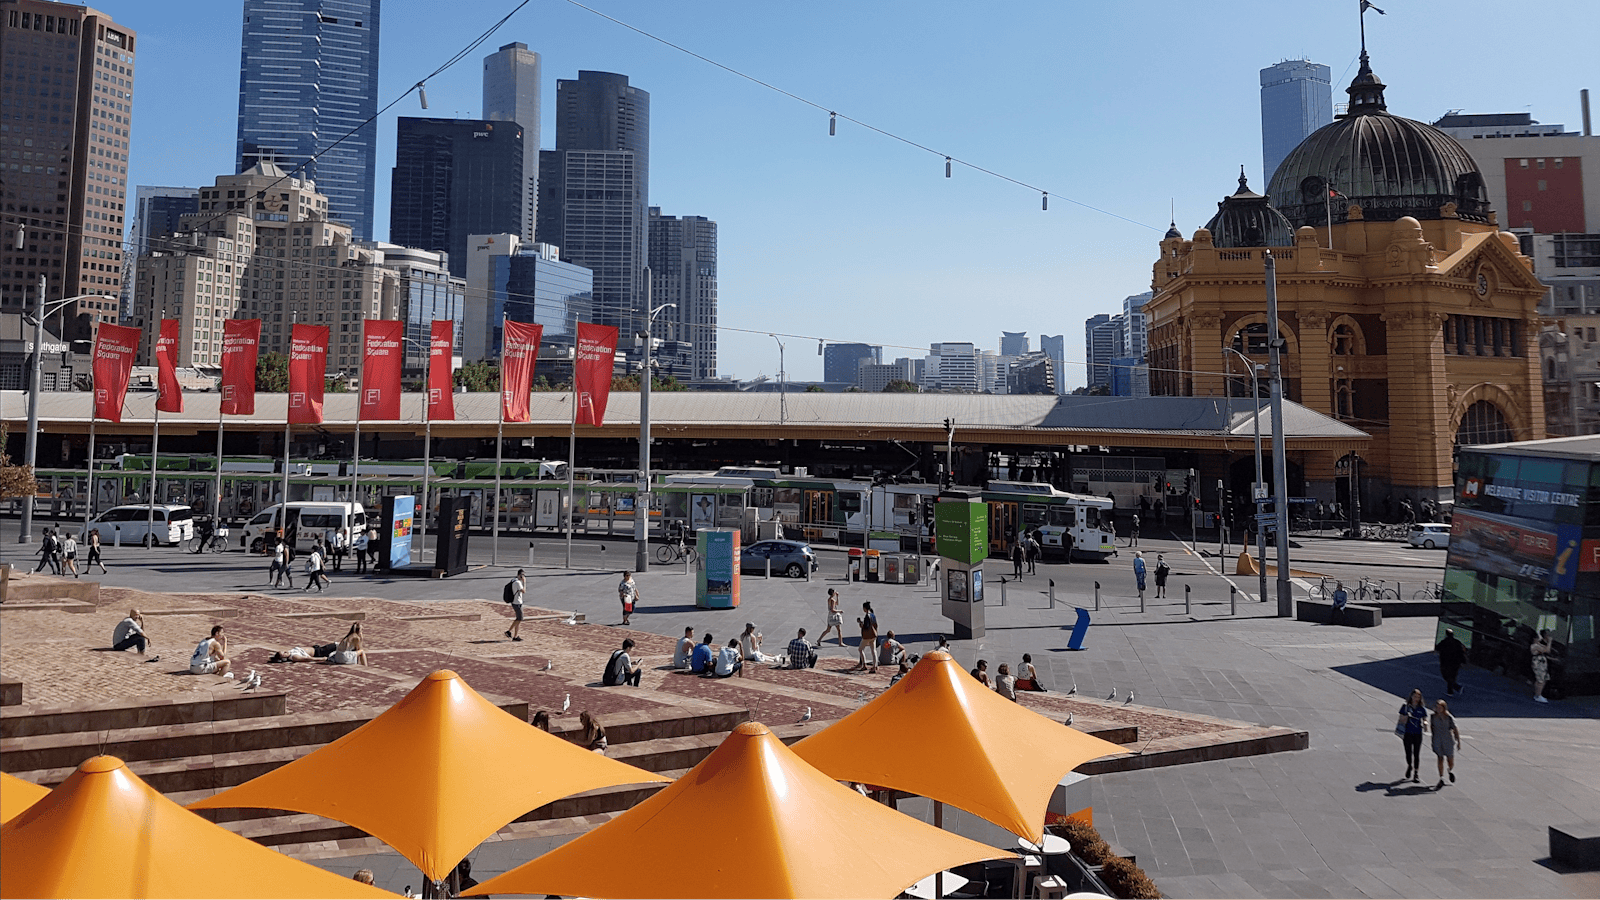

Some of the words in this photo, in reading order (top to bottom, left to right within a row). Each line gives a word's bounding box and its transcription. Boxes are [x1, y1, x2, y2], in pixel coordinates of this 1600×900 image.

[28, 342, 67, 353] Sthgate
[98, 342, 133, 353] Federation
[292, 344, 323, 353] Federation
[367, 340, 399, 348] Federation
[578, 343, 612, 353] Federation
[97, 350, 120, 360] Square
[291, 352, 312, 360] Square
[505, 350, 526, 358] Square
[577, 351, 600, 361] Square
[1485, 485, 1522, 499] MELBOURNE
[1523, 489, 1550, 503] VISITOR
[1551, 492, 1580, 507] CENTRE
